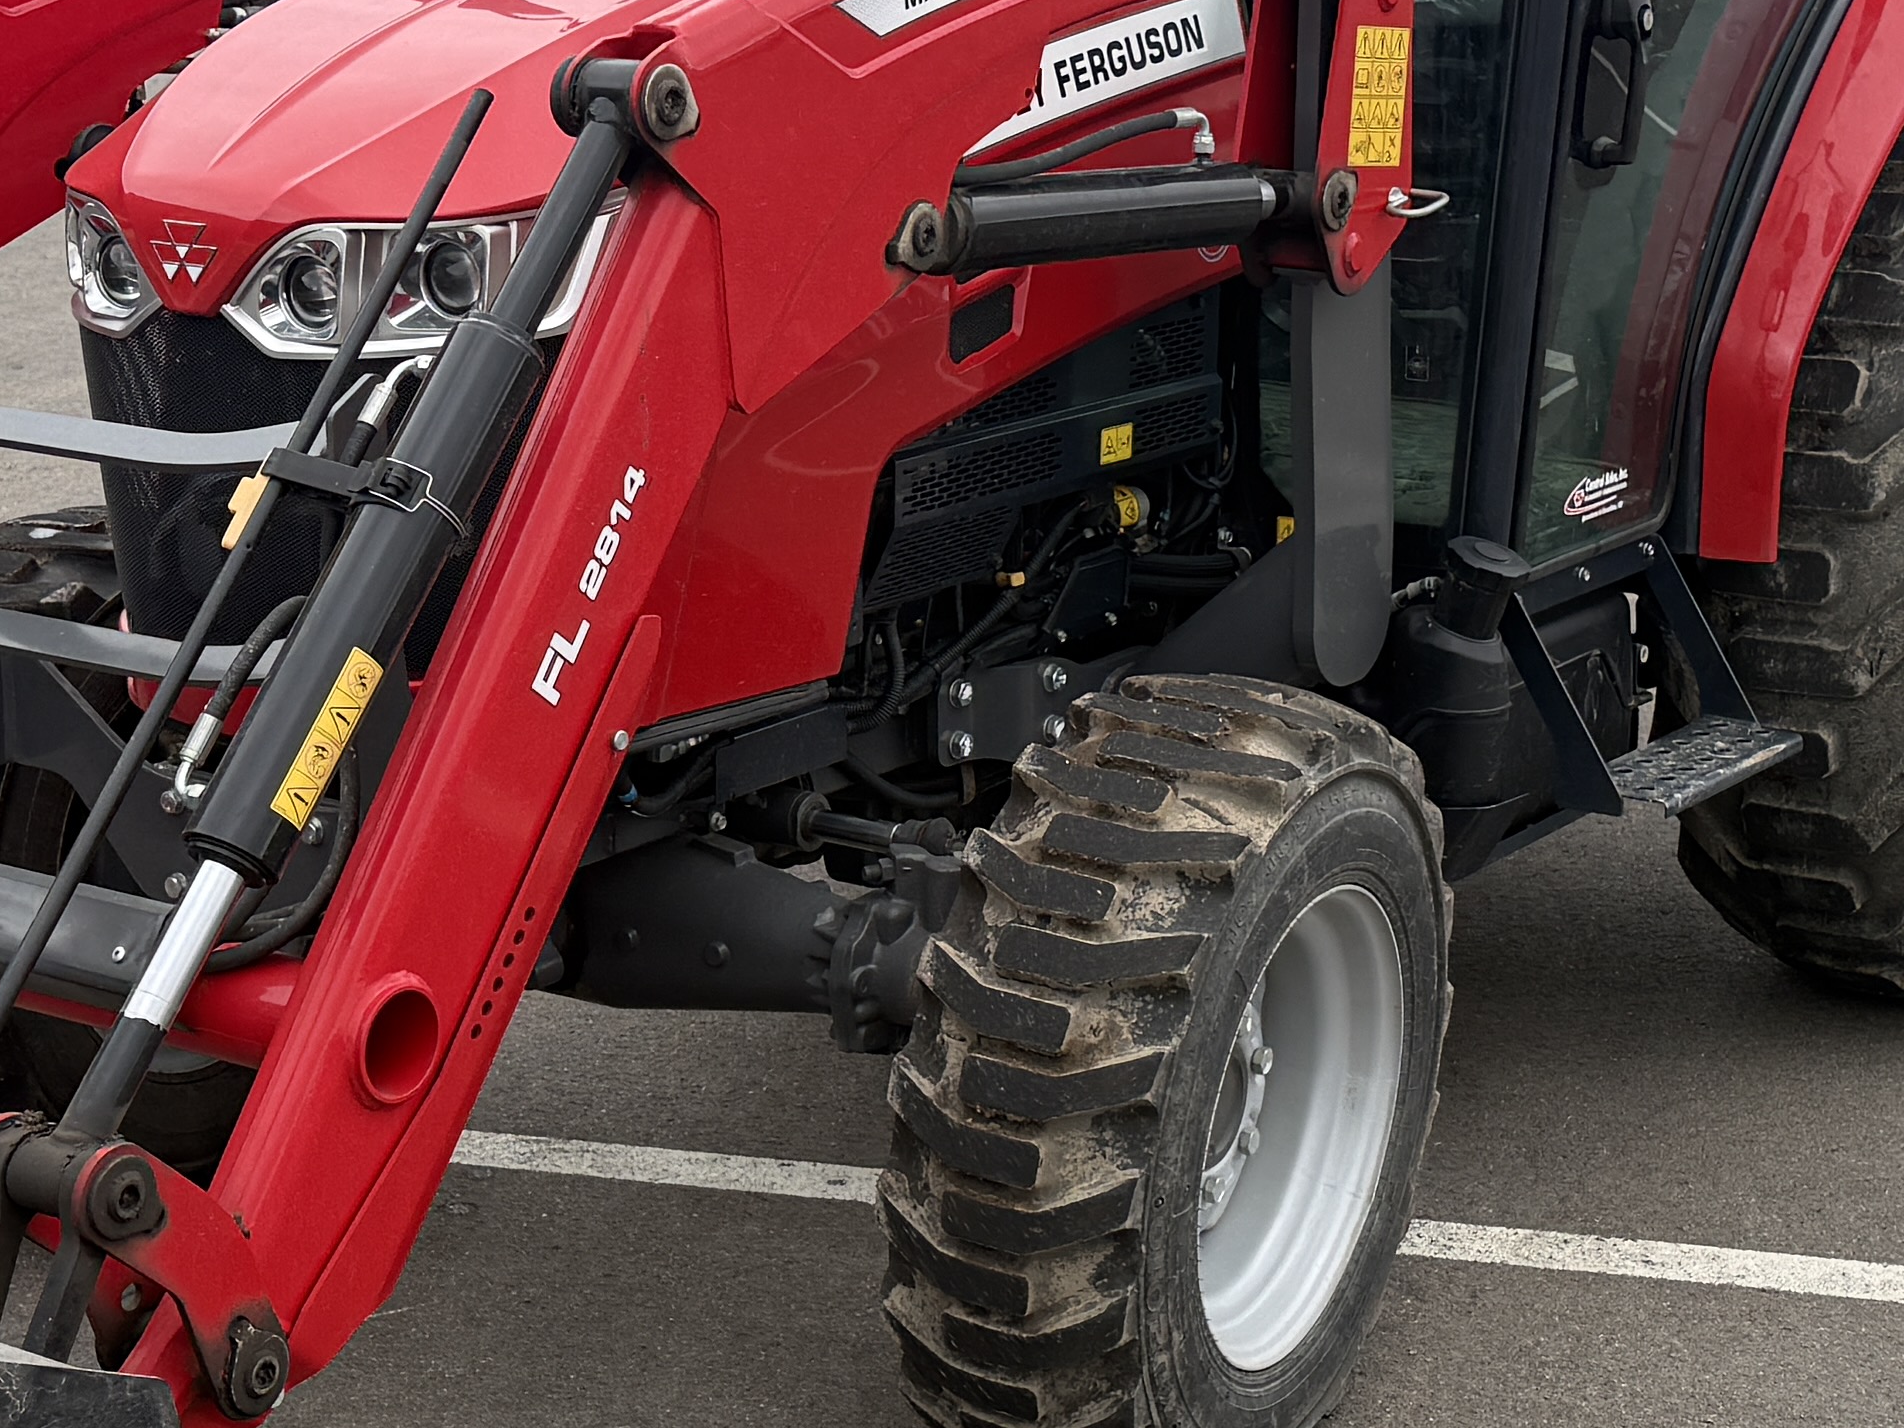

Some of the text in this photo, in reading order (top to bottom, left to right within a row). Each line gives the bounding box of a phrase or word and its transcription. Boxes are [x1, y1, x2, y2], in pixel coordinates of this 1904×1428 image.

[1053, 13, 1205, 99] FERGUSON
[531, 465, 646, 707] FL 2814
